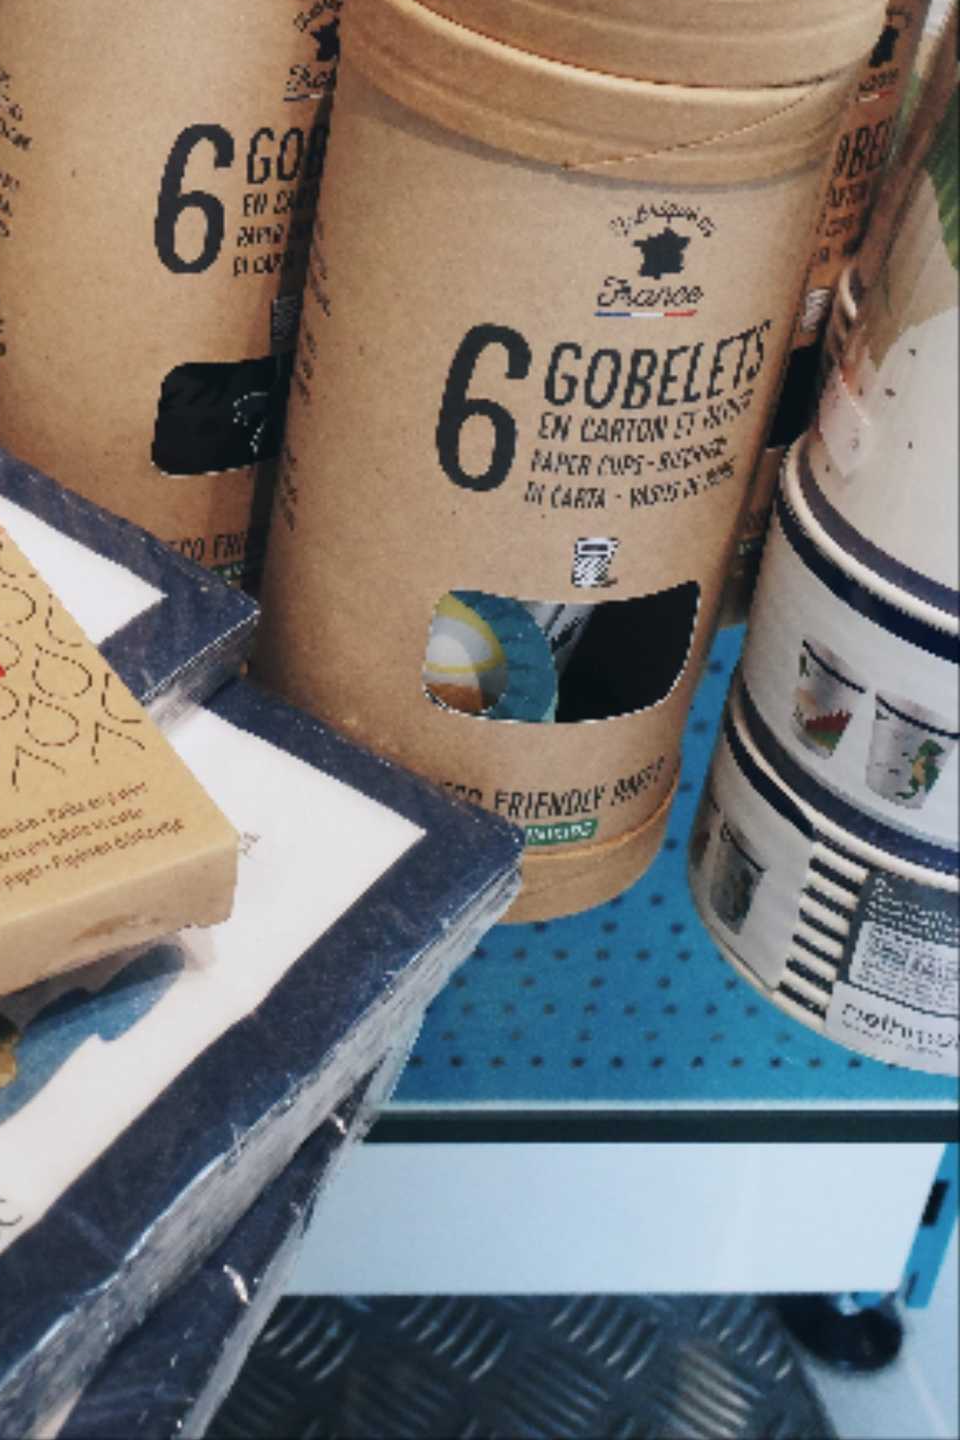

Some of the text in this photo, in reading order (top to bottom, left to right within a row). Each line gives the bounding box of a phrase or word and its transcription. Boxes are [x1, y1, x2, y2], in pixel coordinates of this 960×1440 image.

[154, 124, 235, 274] 6
[436, 323, 532, 492] 6
[544, 319, 772, 410] GOBELETS
[538, 412, 573, 443] EN
[580, 417, 668, 444] CARTON
[493, 784, 607, 820] FRIENDLY
